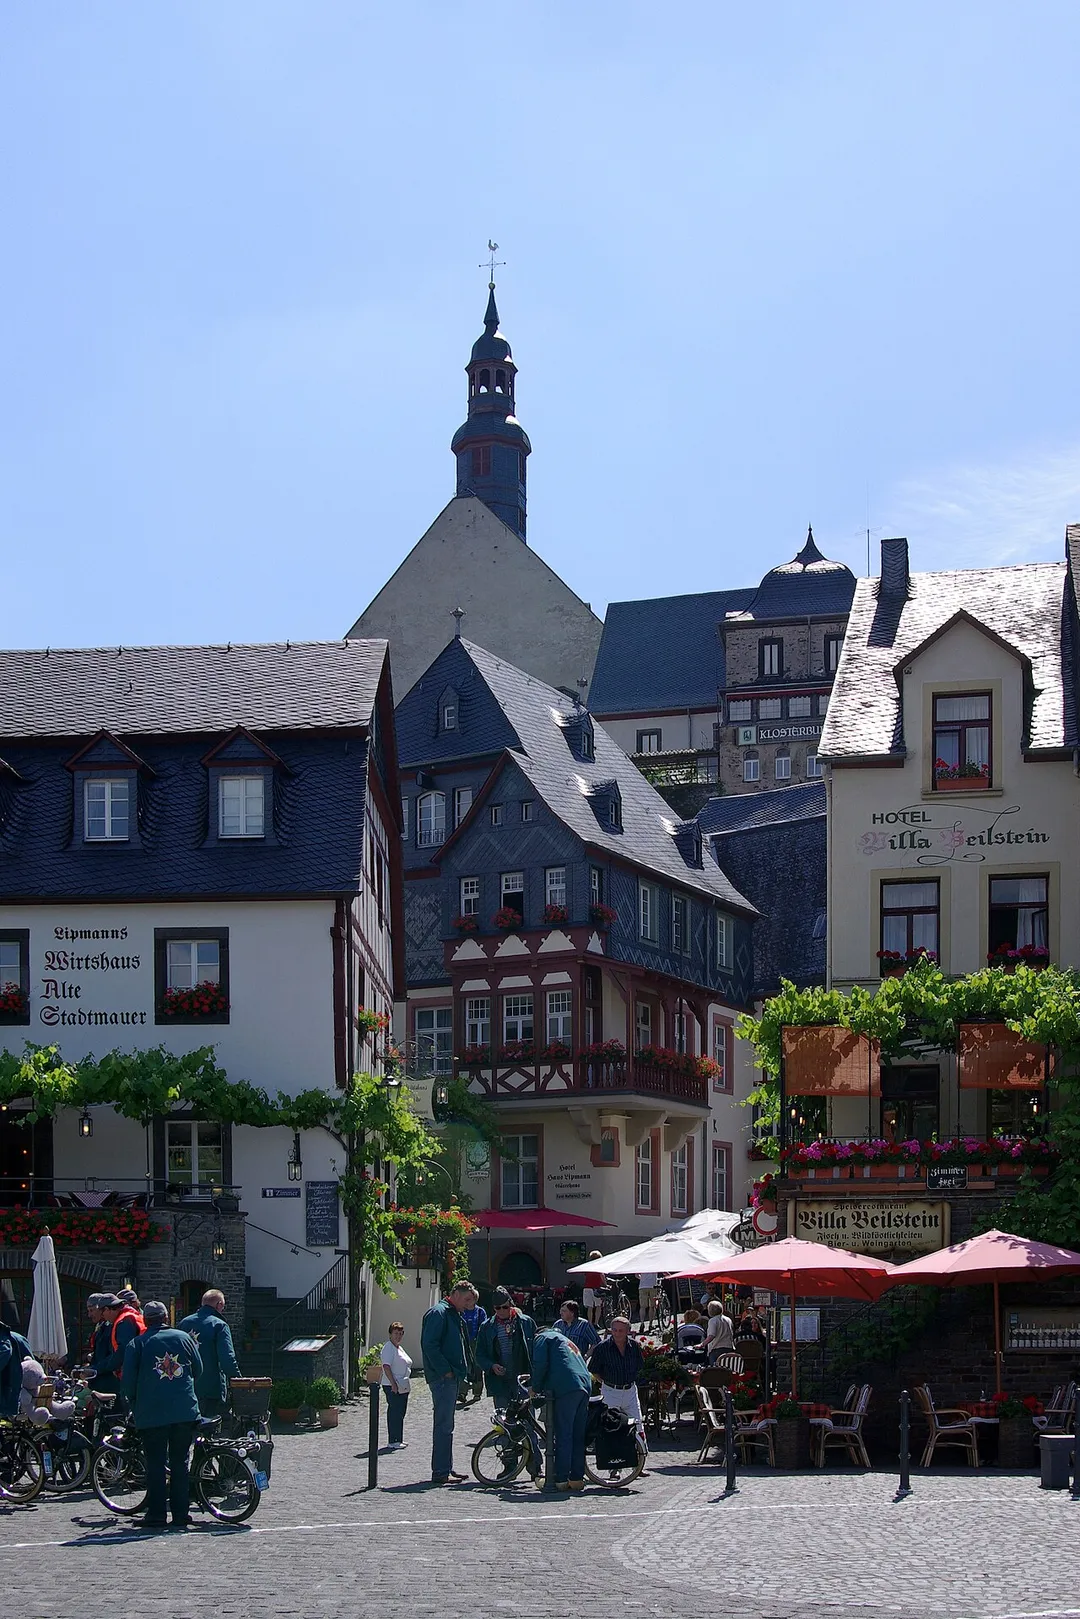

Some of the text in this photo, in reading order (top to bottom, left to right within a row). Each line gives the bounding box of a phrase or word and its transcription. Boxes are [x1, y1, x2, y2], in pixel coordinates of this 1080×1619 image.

[872, 811, 932, 825] HOTEL
[860, 827, 1050, 853] Villa Beilstein
[54, 926, 128, 943] Lipmanns
[44, 950, 141, 972] Wirtshaus
[40, 978, 82, 1000] Alte
[40, 1005, 147, 1026] Stadtmauer
[930, 1165, 966, 1177] Zimmer
[275, 1189, 299, 1197] Zimmer
[798, 1210, 940, 1229] Villa Beilstein
[816, 1231, 841, 1242] Fisch
[827, 1240, 849, 1248] Bier-
[862, 1239, 912, 1248] Weingarten
